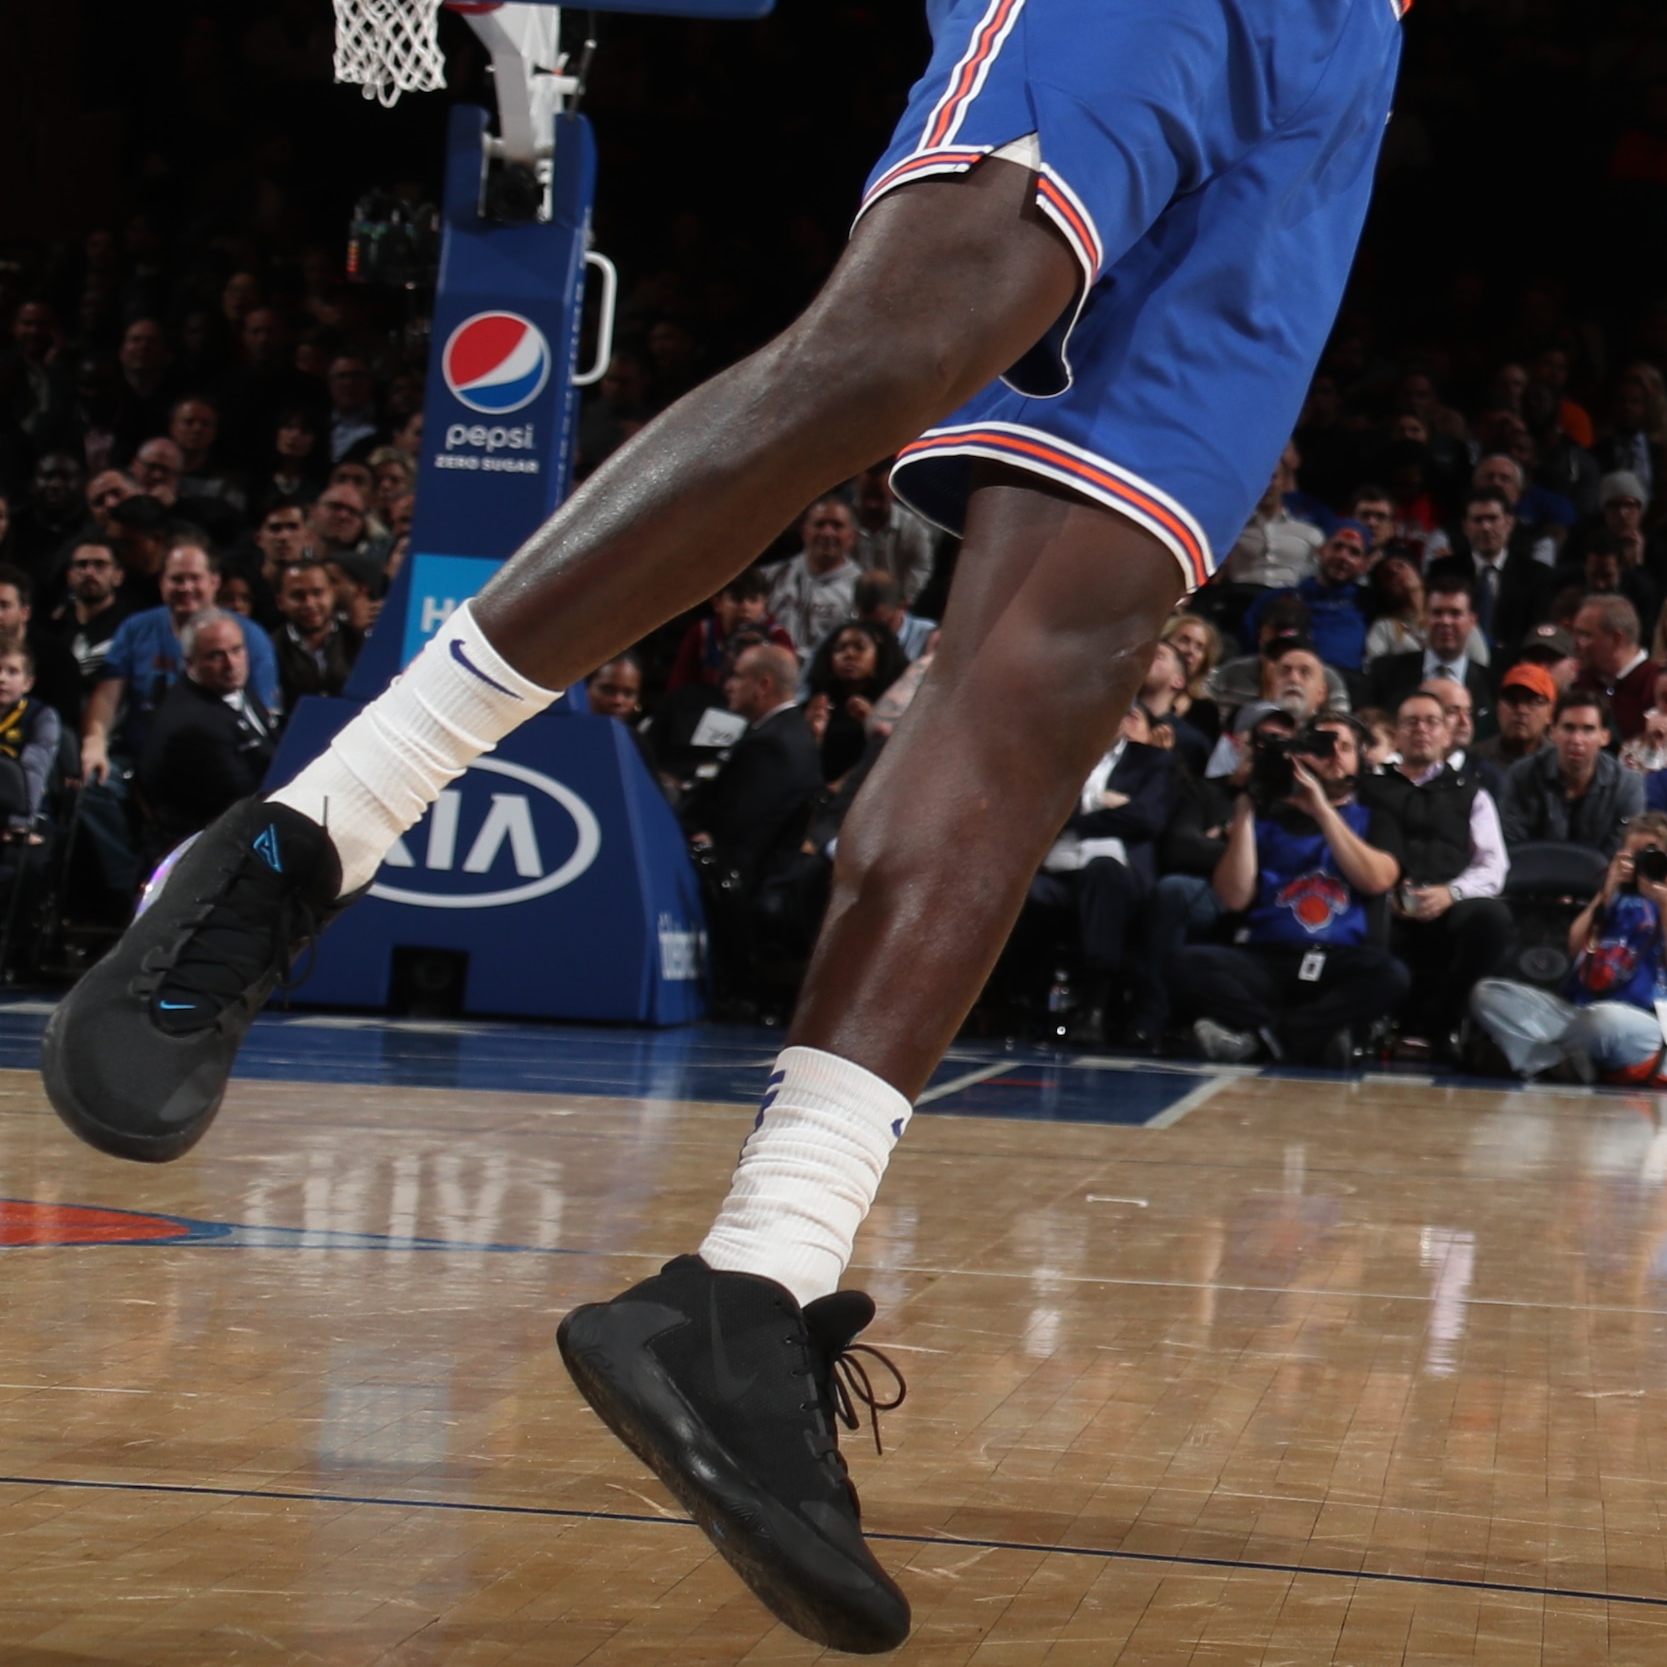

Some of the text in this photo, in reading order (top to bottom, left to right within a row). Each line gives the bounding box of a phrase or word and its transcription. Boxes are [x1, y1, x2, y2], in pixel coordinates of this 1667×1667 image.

[444, 422, 535, 453] pepsi
[433, 453, 541, 475] ZERO SUGAR
